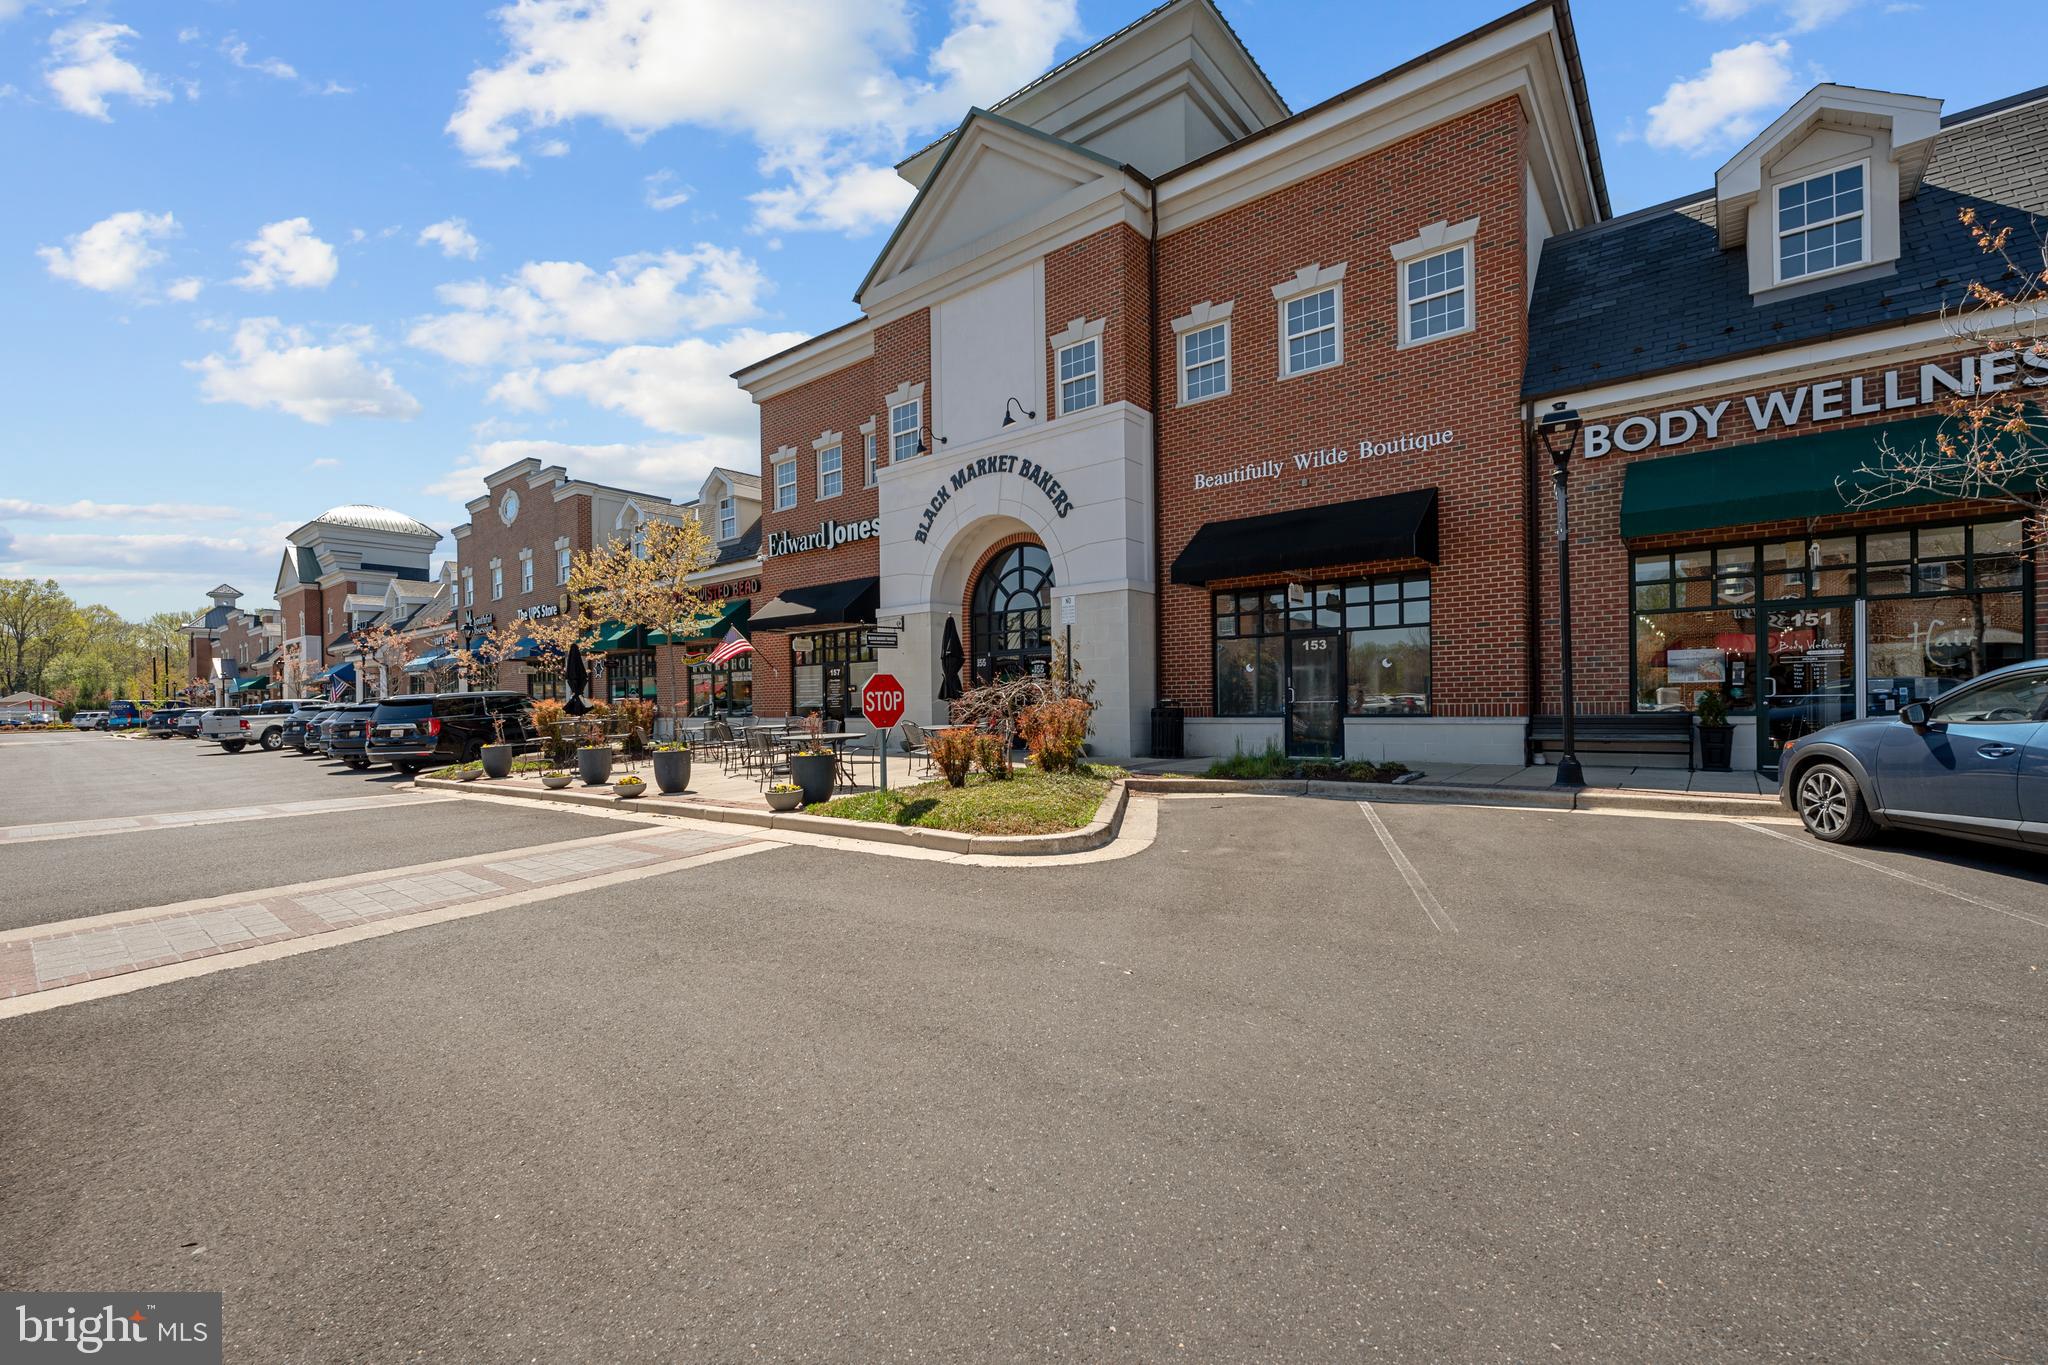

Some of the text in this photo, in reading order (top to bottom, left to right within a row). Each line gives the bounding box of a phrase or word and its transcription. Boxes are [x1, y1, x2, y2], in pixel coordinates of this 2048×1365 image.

[1584, 400, 1731, 459] BODY
[1194, 429, 1454, 490] Beautifully Wilde Boutique
[915, 455, 1074, 544] BLACK MARKET BAKERS
[732, 579, 758, 597] BEAD
[517, 604, 558, 620] The UPS Store
[1791, 611, 1832, 627] 151
[1303, 640, 1327, 651] 153
[1775, 639, 1804, 654] Body
[1806, 638, 1848, 650] Wellness
[1908, 619, 1978, 667] Hair
[830, 668, 841, 676] 157
[865, 690, 902, 712] STOP
